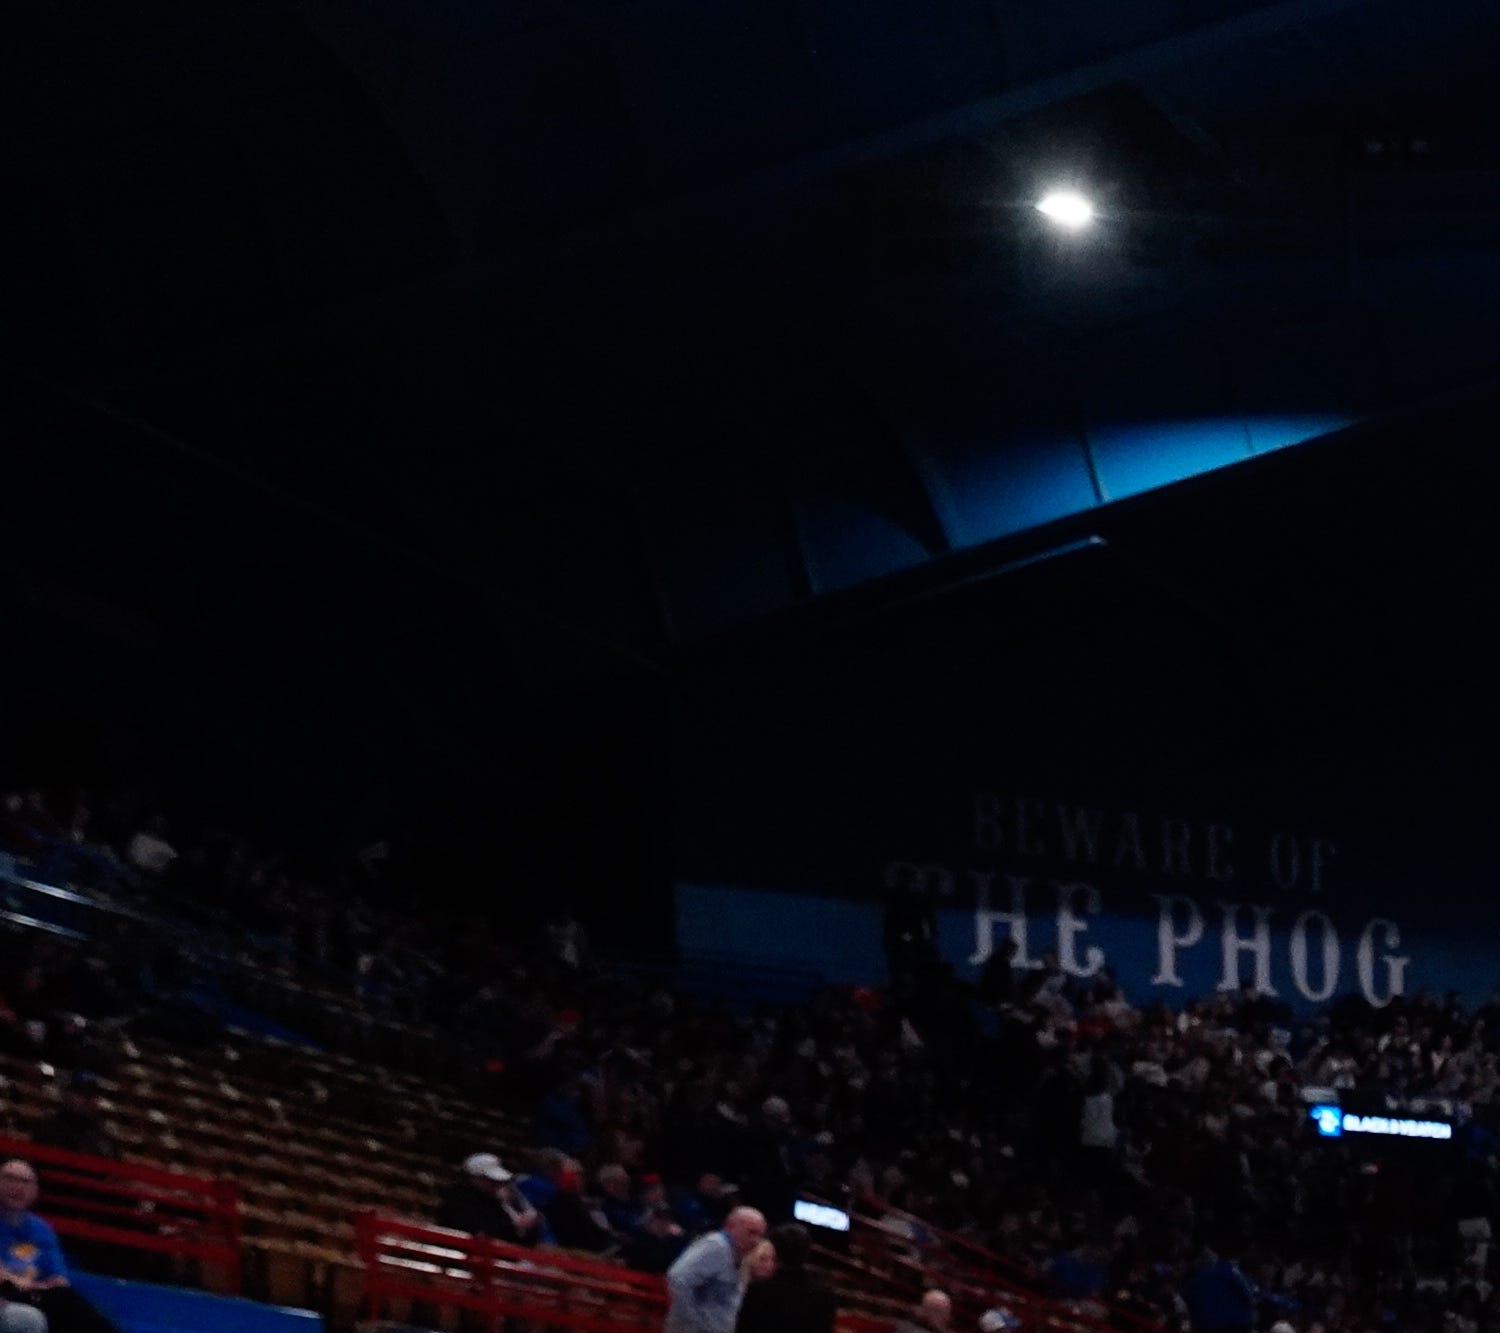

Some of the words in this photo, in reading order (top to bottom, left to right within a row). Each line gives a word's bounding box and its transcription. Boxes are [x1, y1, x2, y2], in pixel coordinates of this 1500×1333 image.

[973, 793, 1235, 882] BEWARE
[1270, 832, 1338, 893] OF
[1151, 892, 1411, 1009] PHOG
